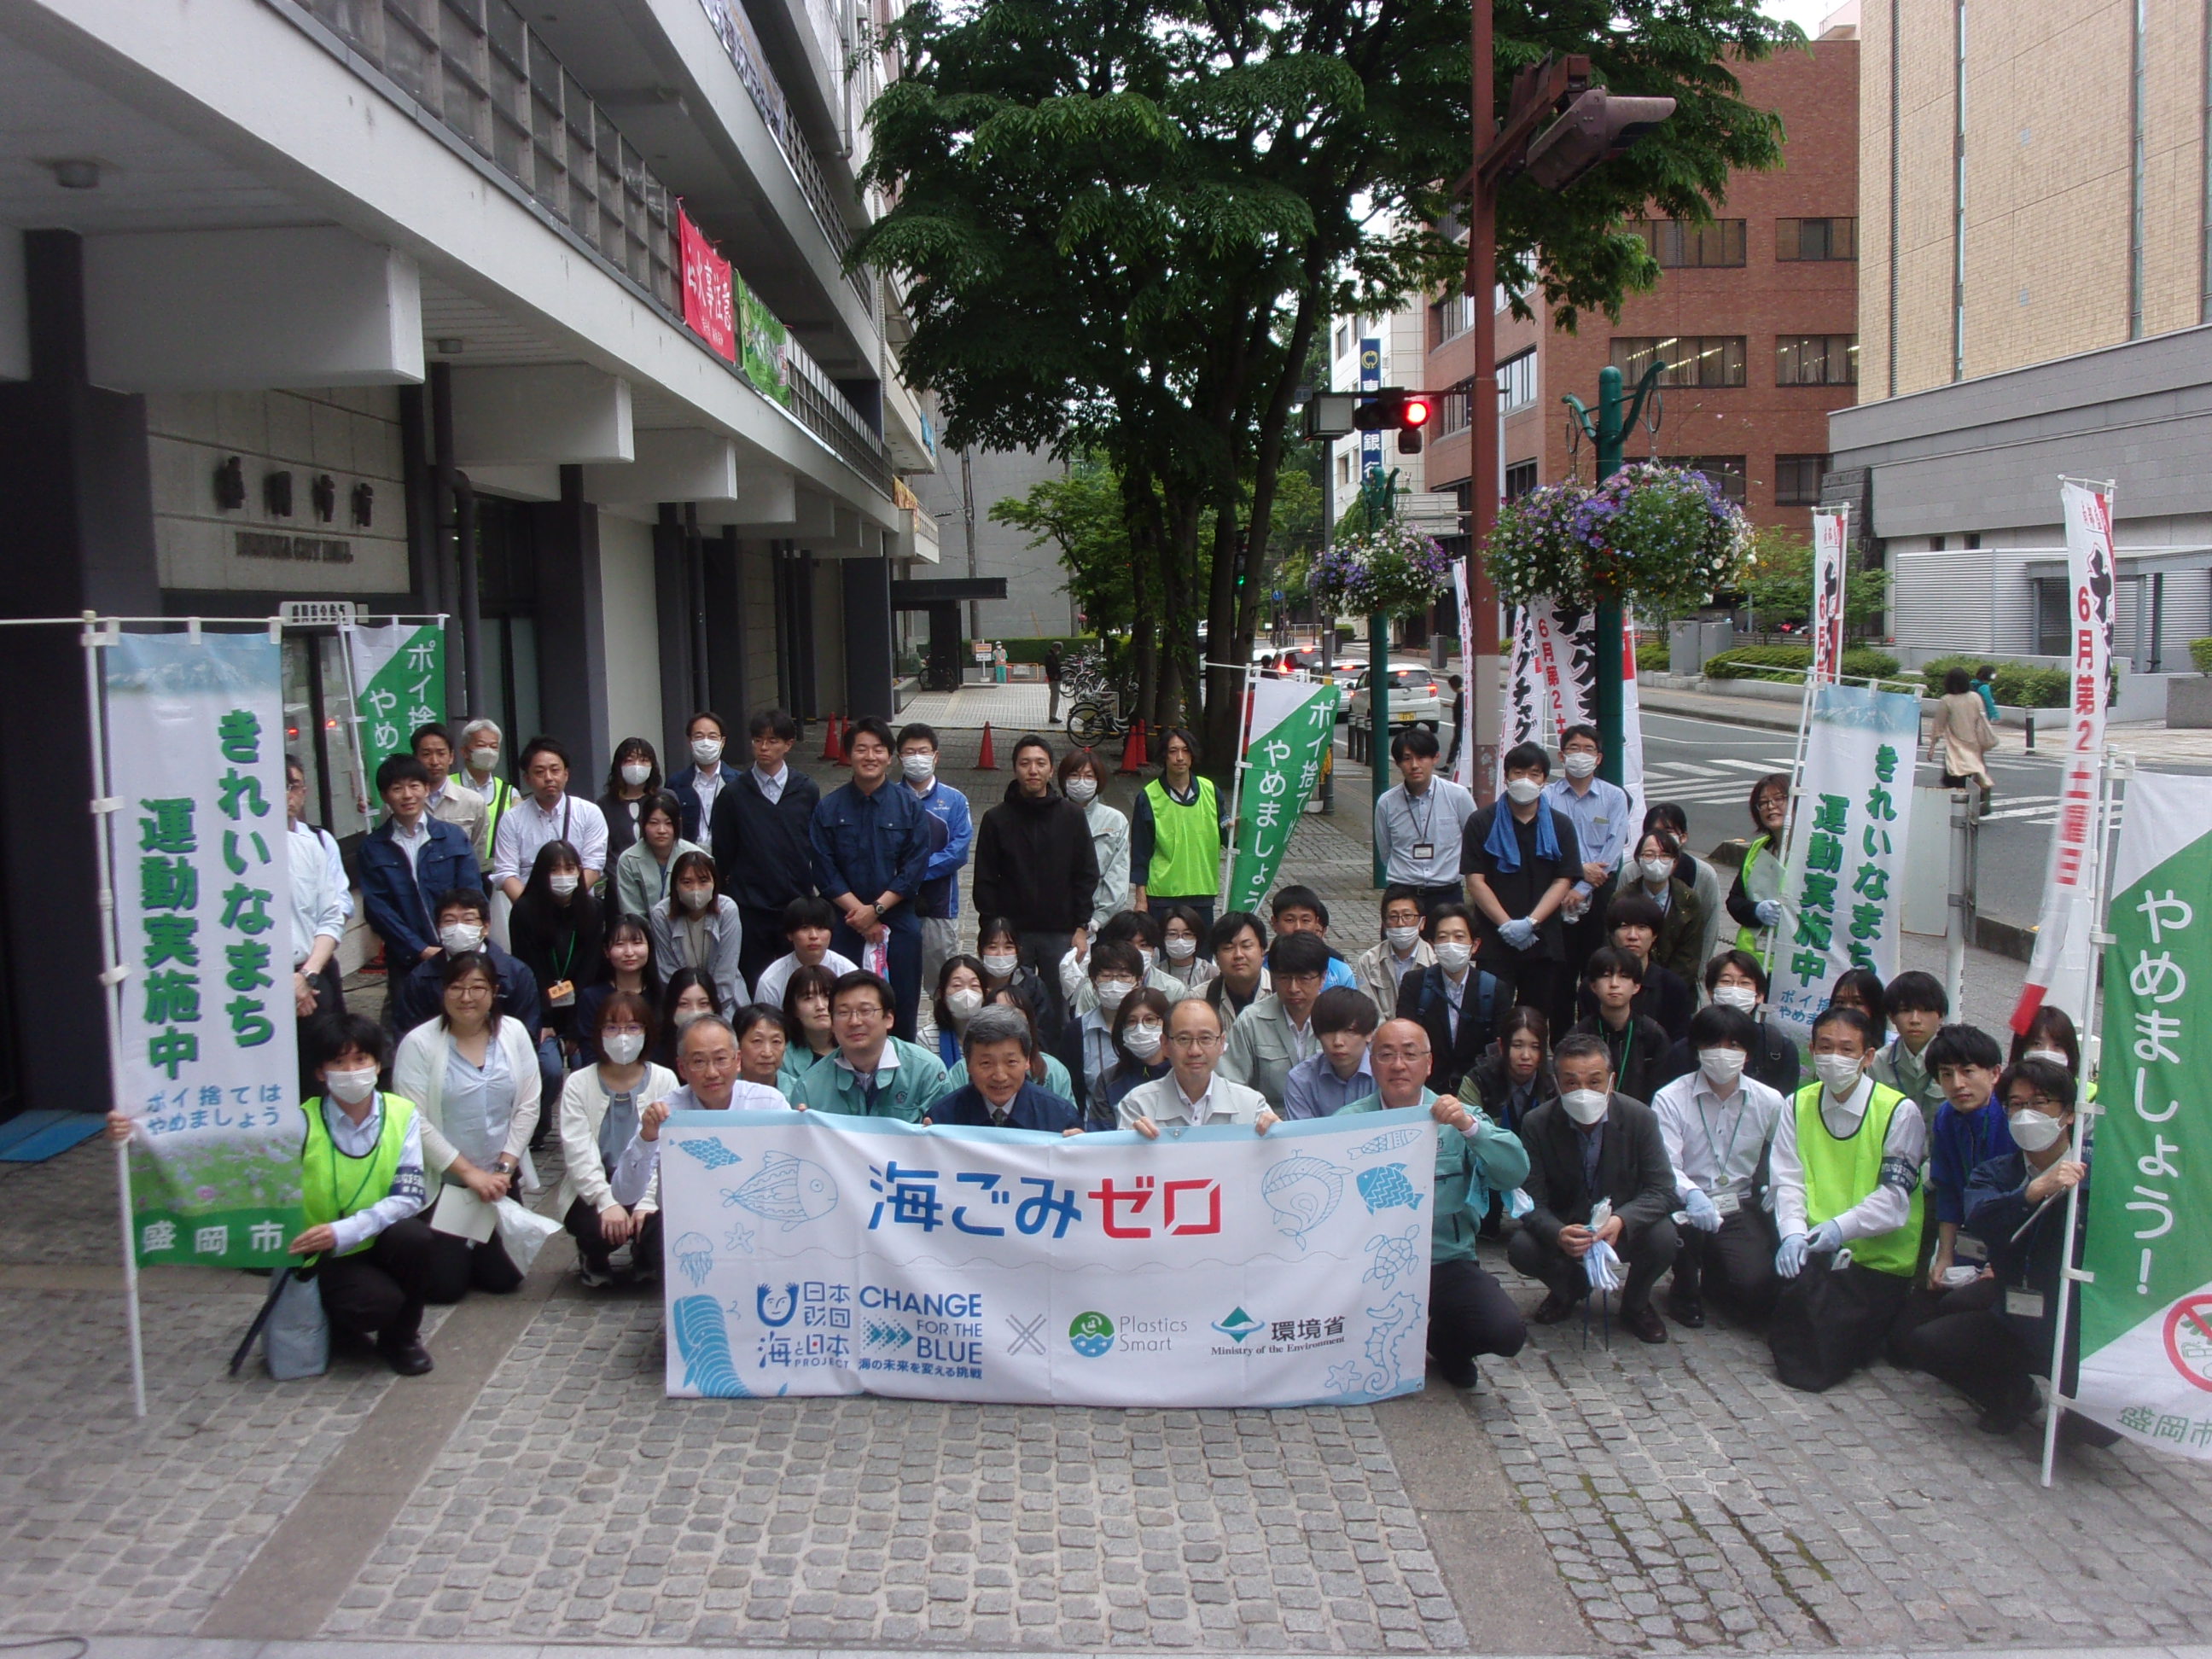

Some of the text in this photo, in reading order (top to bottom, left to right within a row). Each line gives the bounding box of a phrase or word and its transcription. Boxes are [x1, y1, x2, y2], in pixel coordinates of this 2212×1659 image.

[370, 688, 399, 761] やめ
[1243, 738, 1291, 914] やめましょう
[1846, 742, 1900, 975] きれいなまち
[217, 708, 275, 1048] きれいなまち
[1790, 792, 1850, 988] 運動実施中
[138, 797, 202, 1080] 運動実施中
[146, 1084, 282, 1113] ポイ捨ては
[146, 1106, 282, 1136] やめましょう
[867, 1161, 1221, 1239] 海ごみゼロ
[142, 1219, 286, 1256] 盛岡市
[803, 1281, 851, 1304] 日本
[859, 1285, 982, 1318] CHANGE
[803, 1306, 851, 1330] 財団
[917, 1319, 982, 1337] FOR THE
[1120, 1315, 1188, 1333] Plastics
[1271, 1316, 1346, 1342] 環境省
[757, 1330, 850, 1369] 海と日本
[917, 1336, 982, 1365] BLUE
[1119, 1334, 1173, 1352] Smart
[1211, 1336, 1345, 1356] Ministry of the Environment
[794, 1357, 849, 1369] PROJECT
[858, 1358, 982, 1380] 海の未来を変える挑戦
